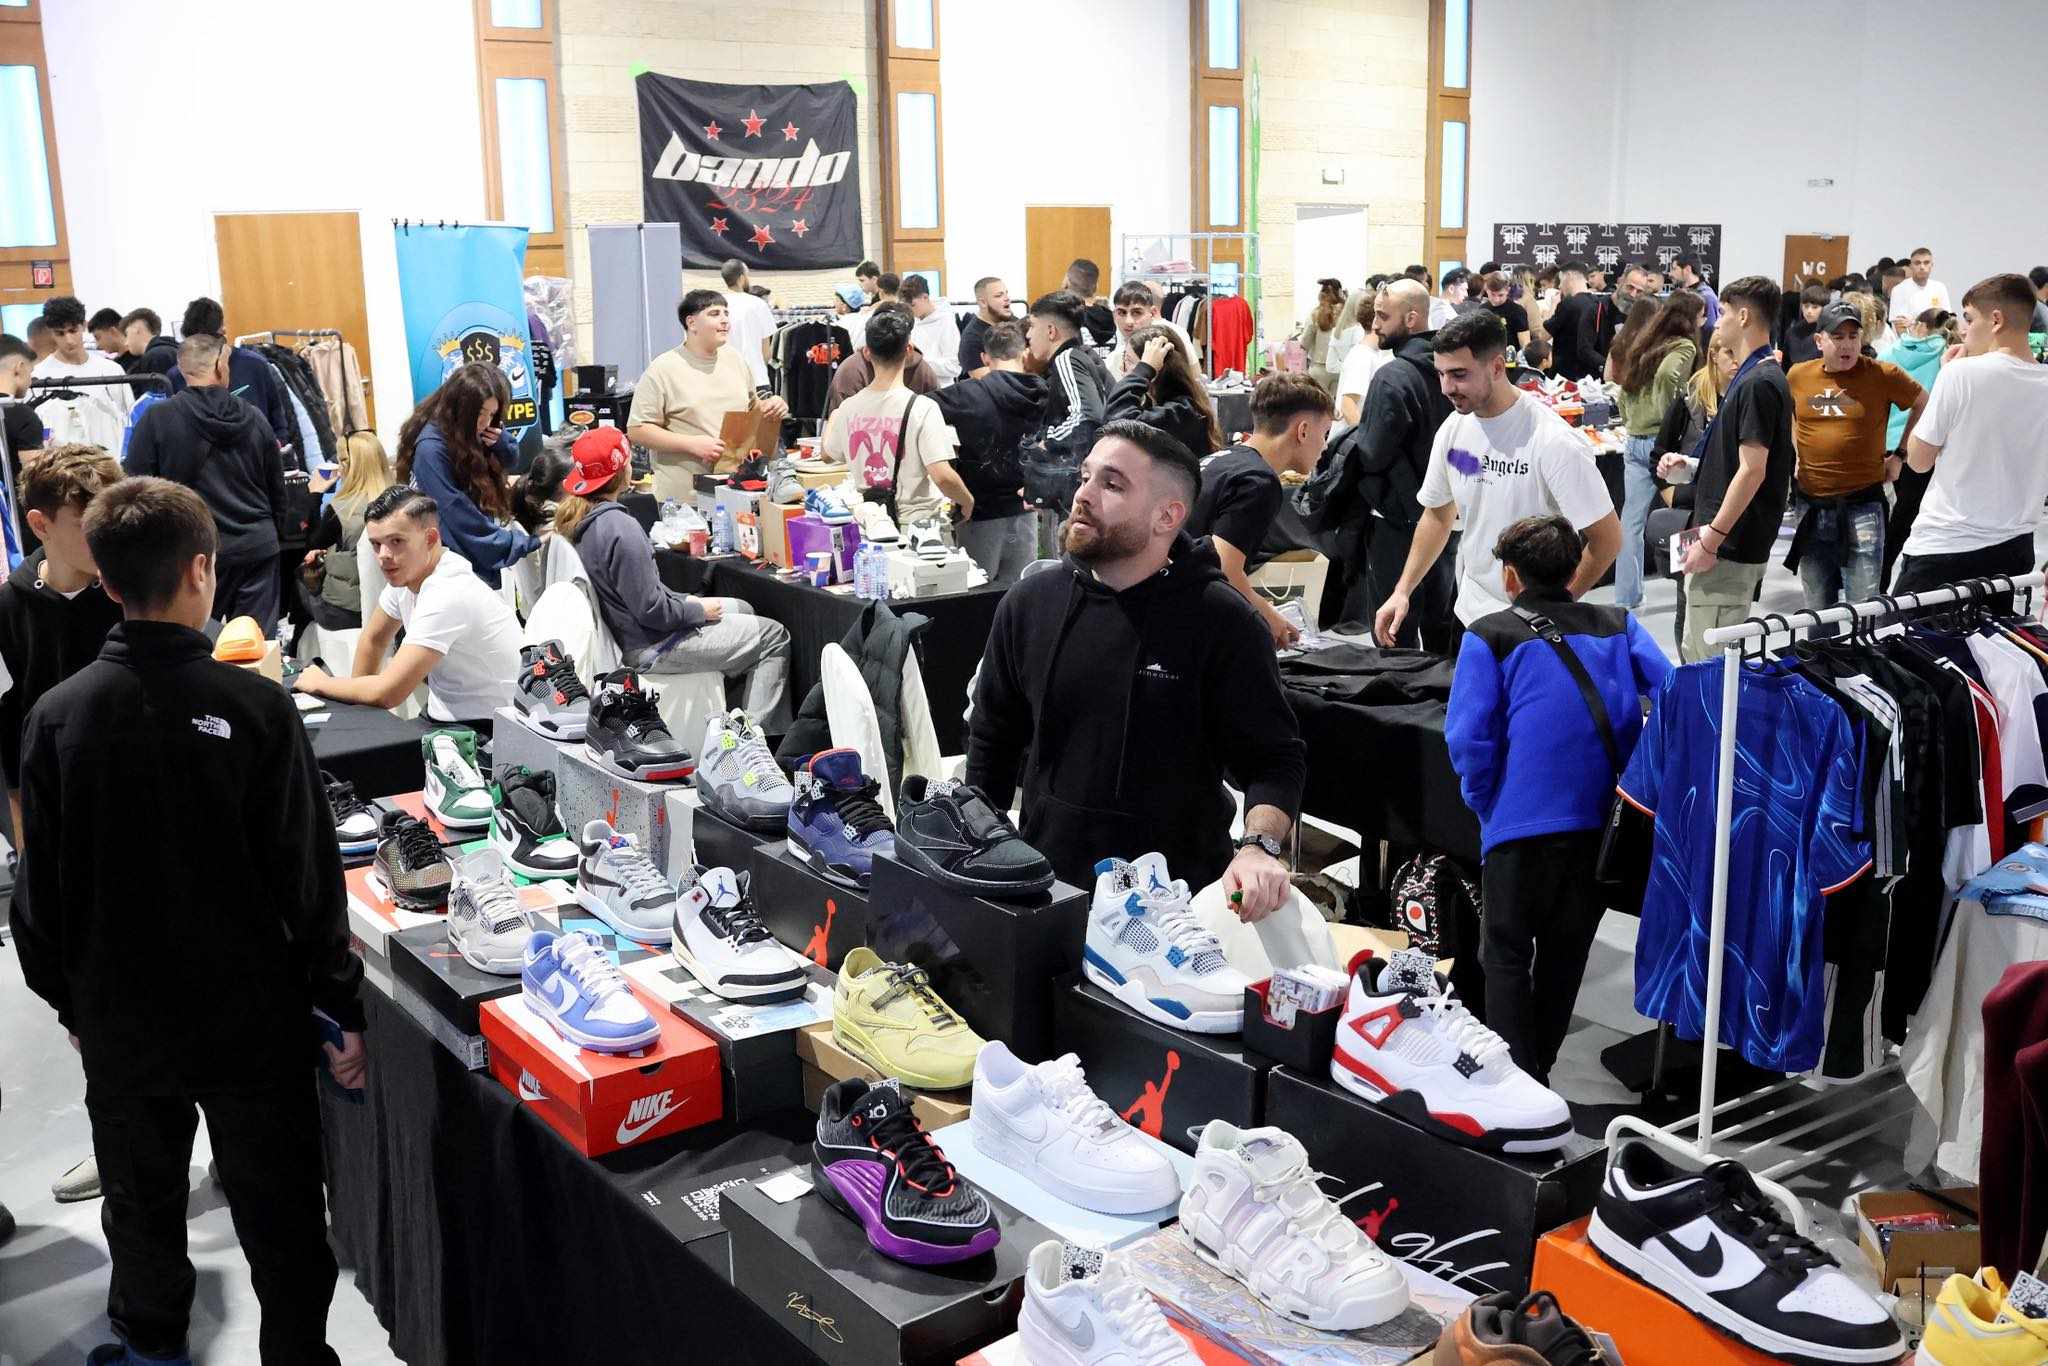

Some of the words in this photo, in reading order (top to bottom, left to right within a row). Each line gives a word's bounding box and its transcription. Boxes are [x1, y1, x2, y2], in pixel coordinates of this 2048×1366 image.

[652, 130, 851, 189] bando
[1802, 260, 1826, 276] WC
[505, 402, 536, 420] YPE
[1481, 454, 1529, 478] Angels
[191, 718, 219, 730] NORTH
[627, 1088, 675, 1124] NIKE
